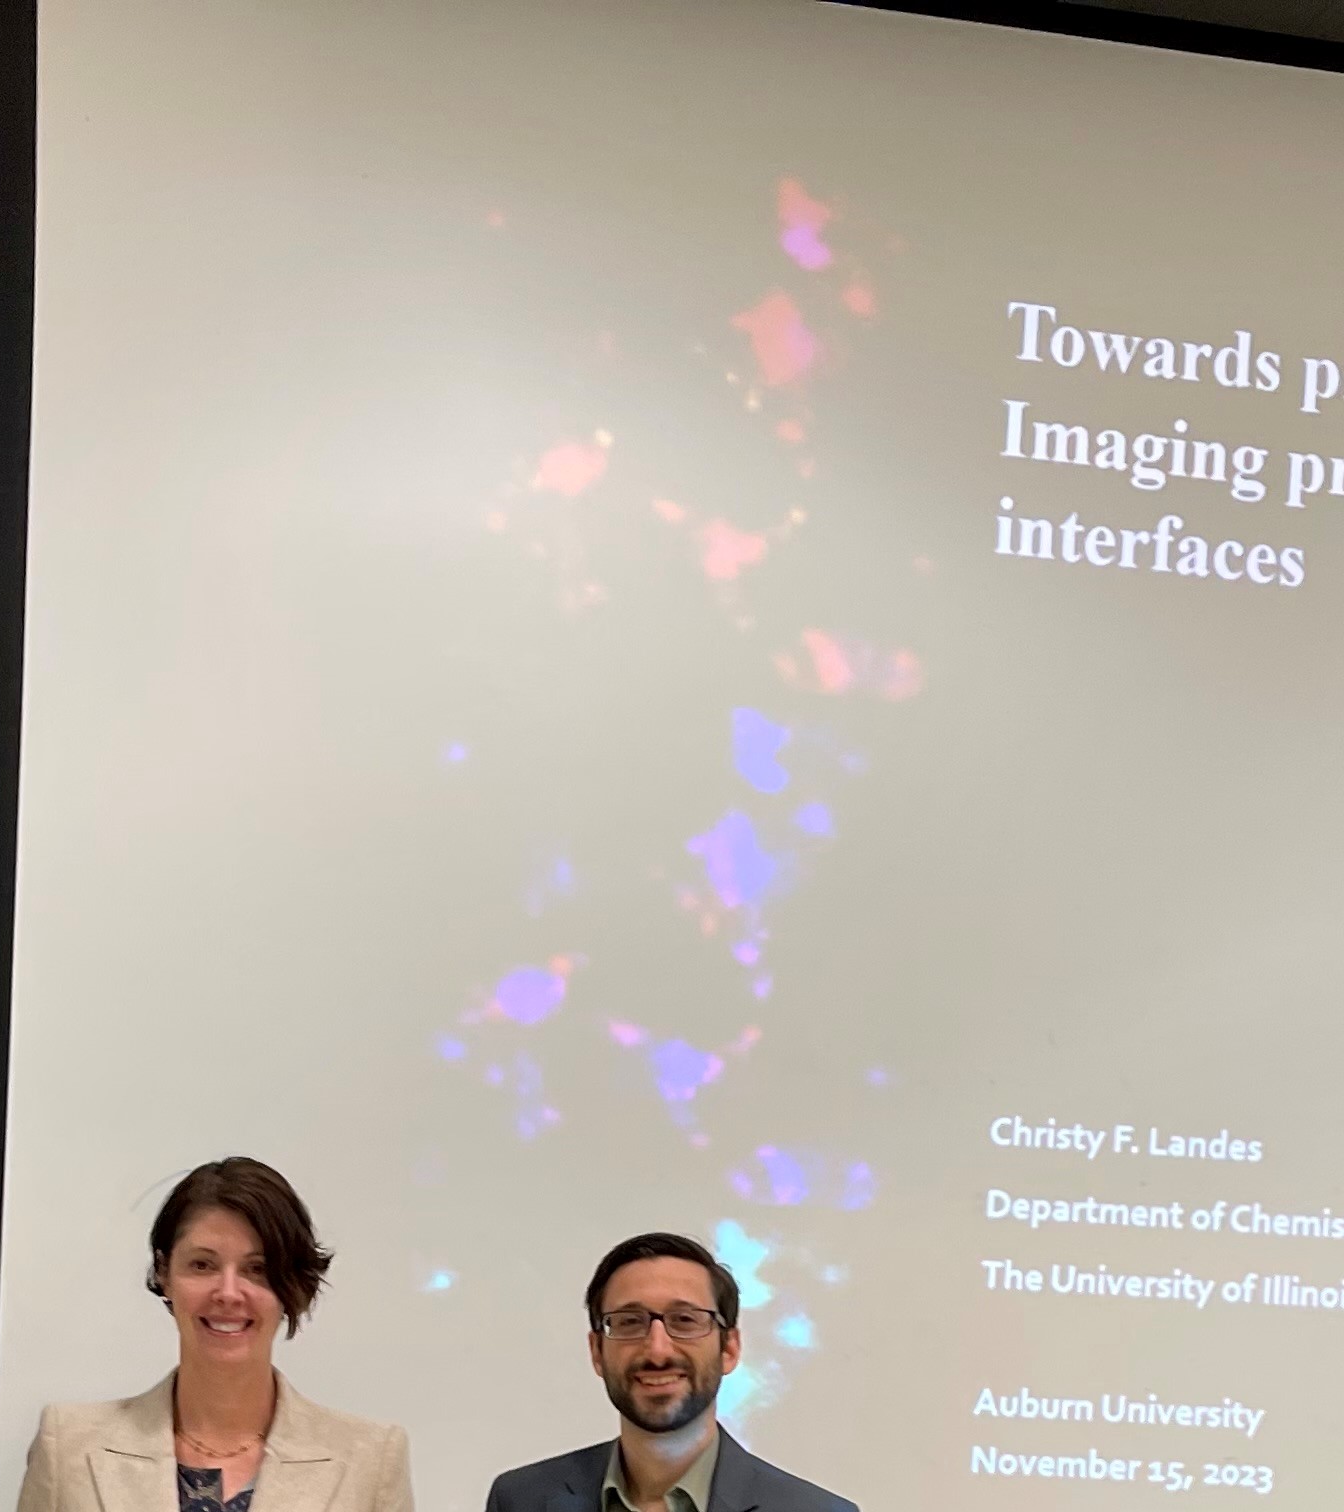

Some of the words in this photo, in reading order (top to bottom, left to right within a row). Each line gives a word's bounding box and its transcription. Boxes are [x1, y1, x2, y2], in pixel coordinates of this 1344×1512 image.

[1008, 301, 1281, 392] Towards
[1000, 399, 1269, 502] Imaging
[993, 495, 1306, 588] interfaces
[990, 1115, 1106, 1160] Christy
[1113, 1125, 1140, 1155] F.
[1148, 1127, 1263, 1163] Landes
[986, 1189, 1185, 1229] Department
[1191, 1201, 1228, 1231] of
[980, 1258, 1044, 1293] The
[1051, 1263, 1216, 1310] University
[1221, 1272, 1259, 1304] of
[972, 1386, 1094, 1422] Auburn
[1101, 1392, 1266, 1438] University
[970, 1445, 1143, 1481] November
[1147, 1460, 1195, 1492] 15,
[1203, 1462, 1275, 1495] 2023
